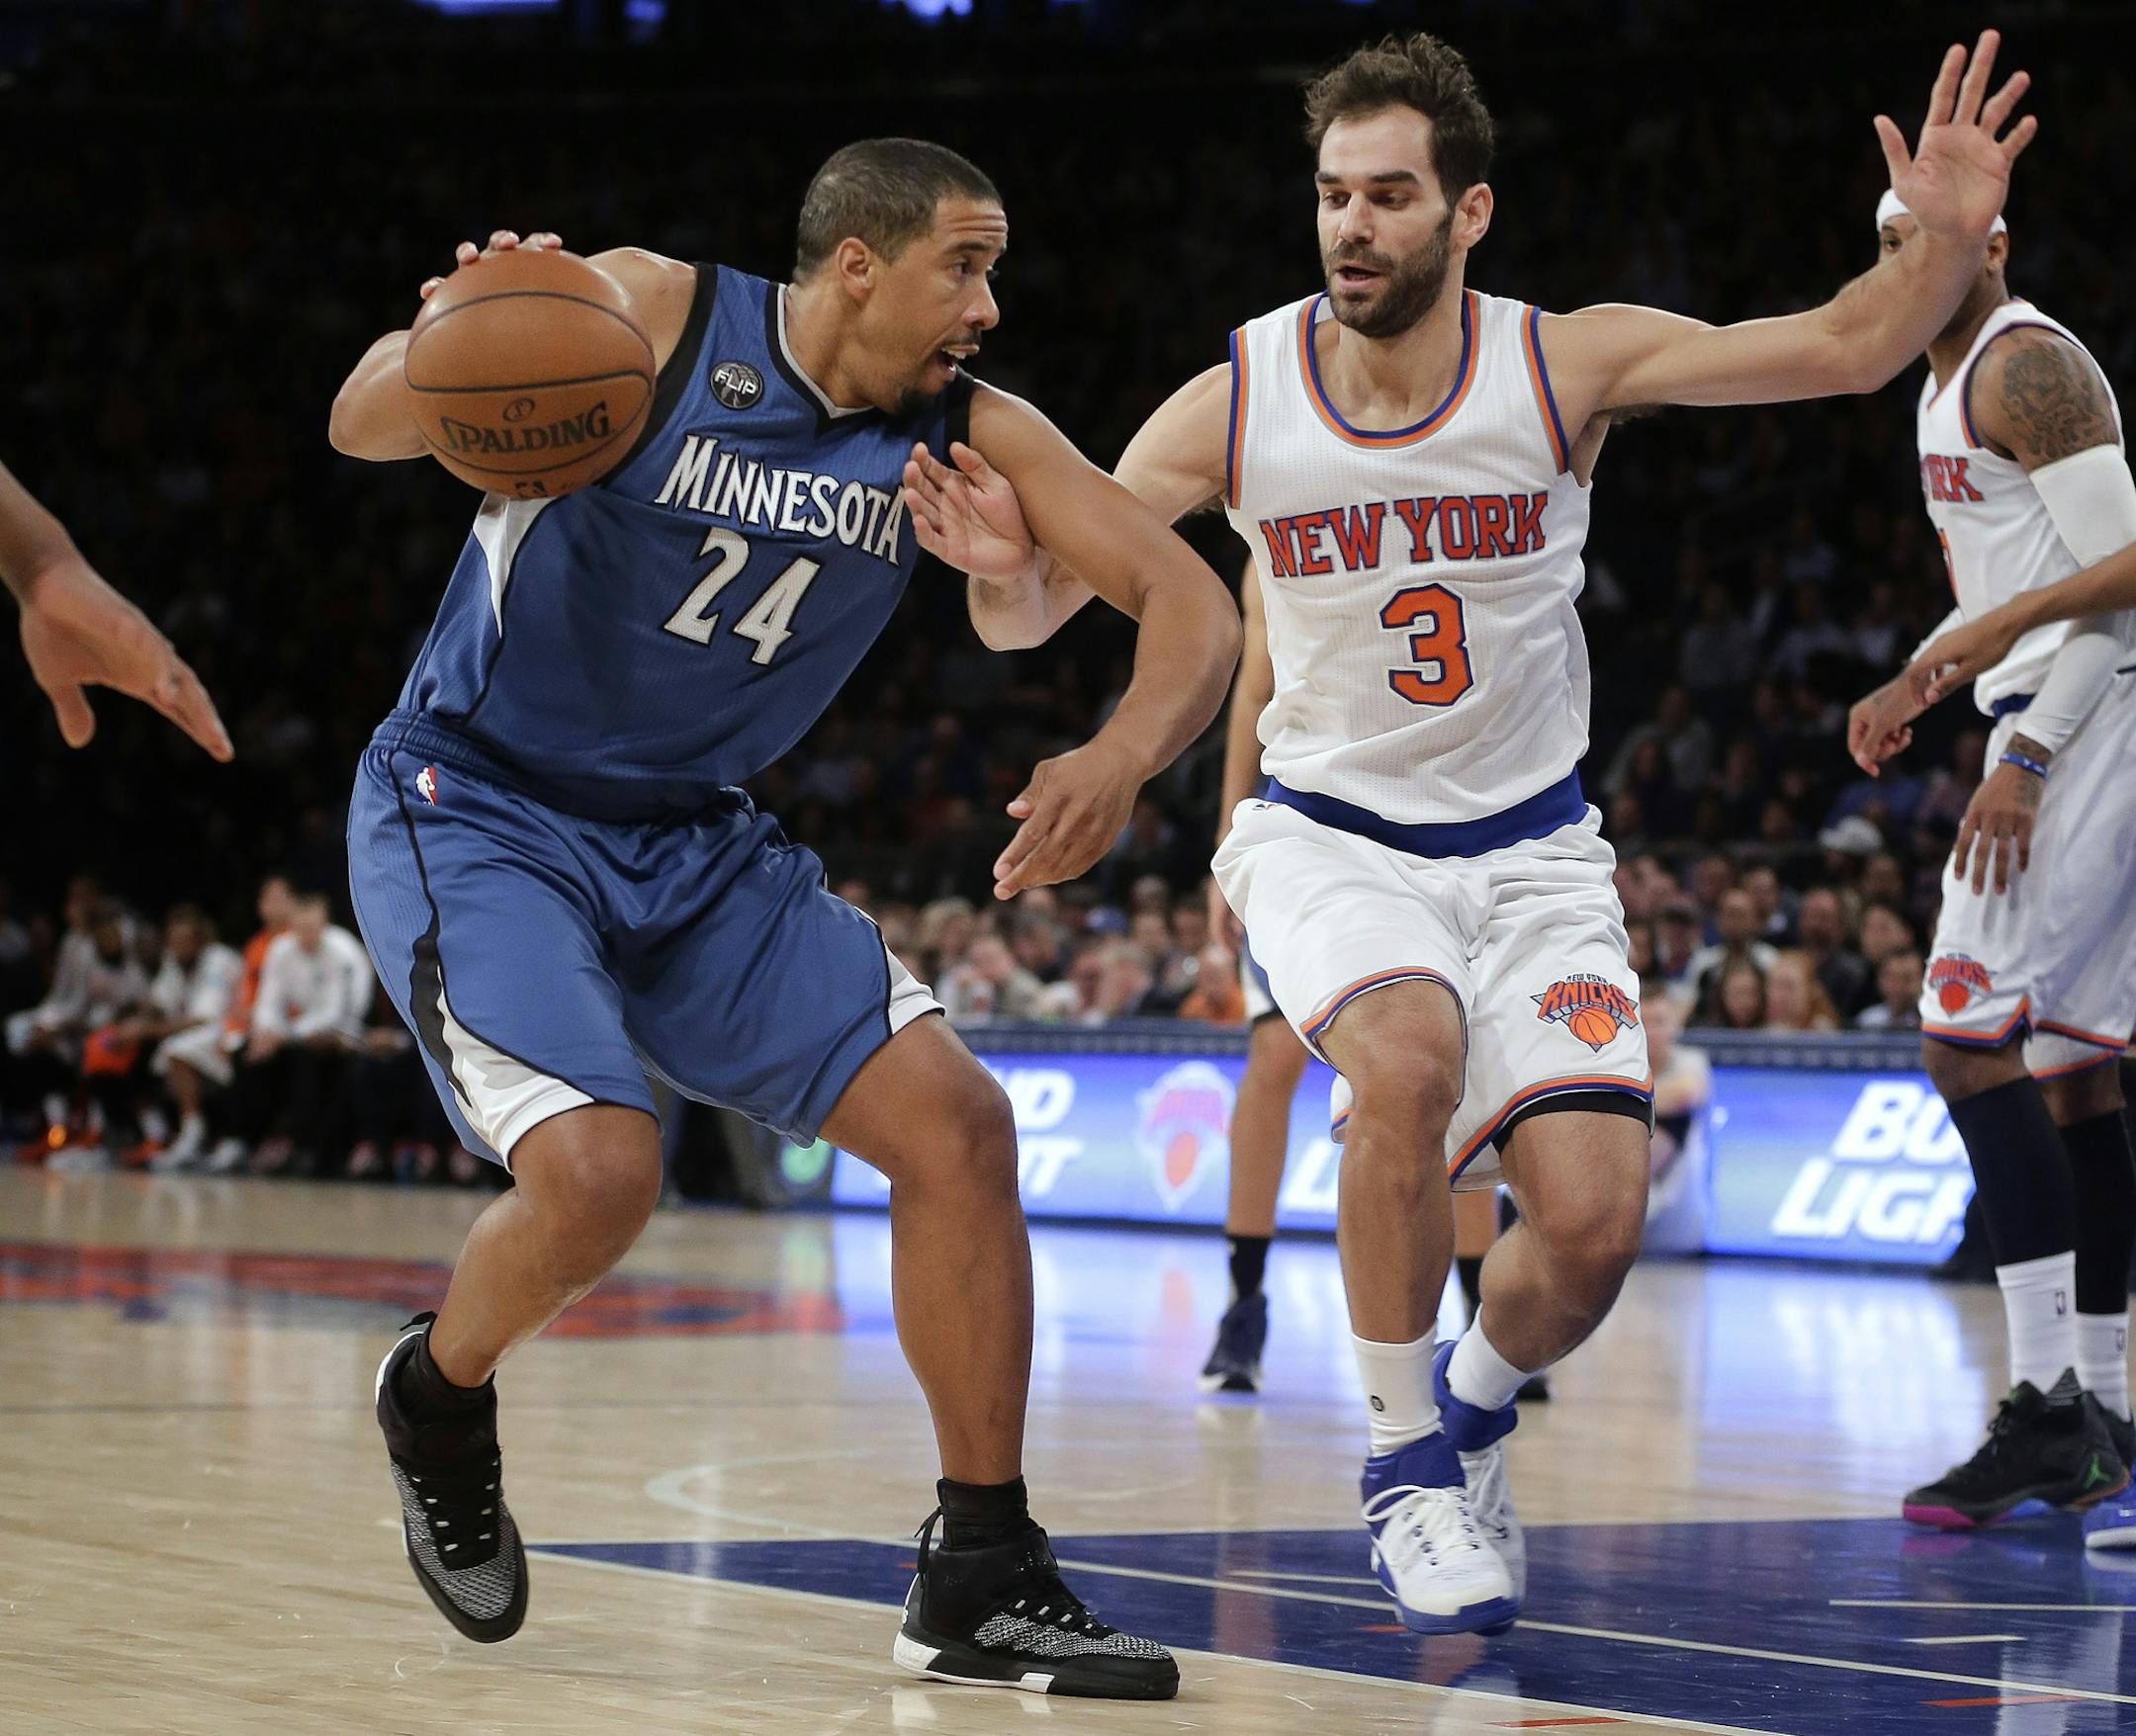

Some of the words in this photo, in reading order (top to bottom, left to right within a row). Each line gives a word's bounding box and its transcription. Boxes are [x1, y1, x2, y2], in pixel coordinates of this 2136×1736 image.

[714, 369, 756, 394] FLIP
[440, 400, 611, 453] SPALDING
[654, 434, 906, 566] MINNESOTA
[1259, 502, 1385, 577] NEW
[1394, 490, 1548, 564] YORK
[664, 527, 822, 665] 24
[1380, 583, 1473, 707] 3
[1537, 981, 1639, 1023] KNICKS
[1832, 1079, 1964, 1160] BU
